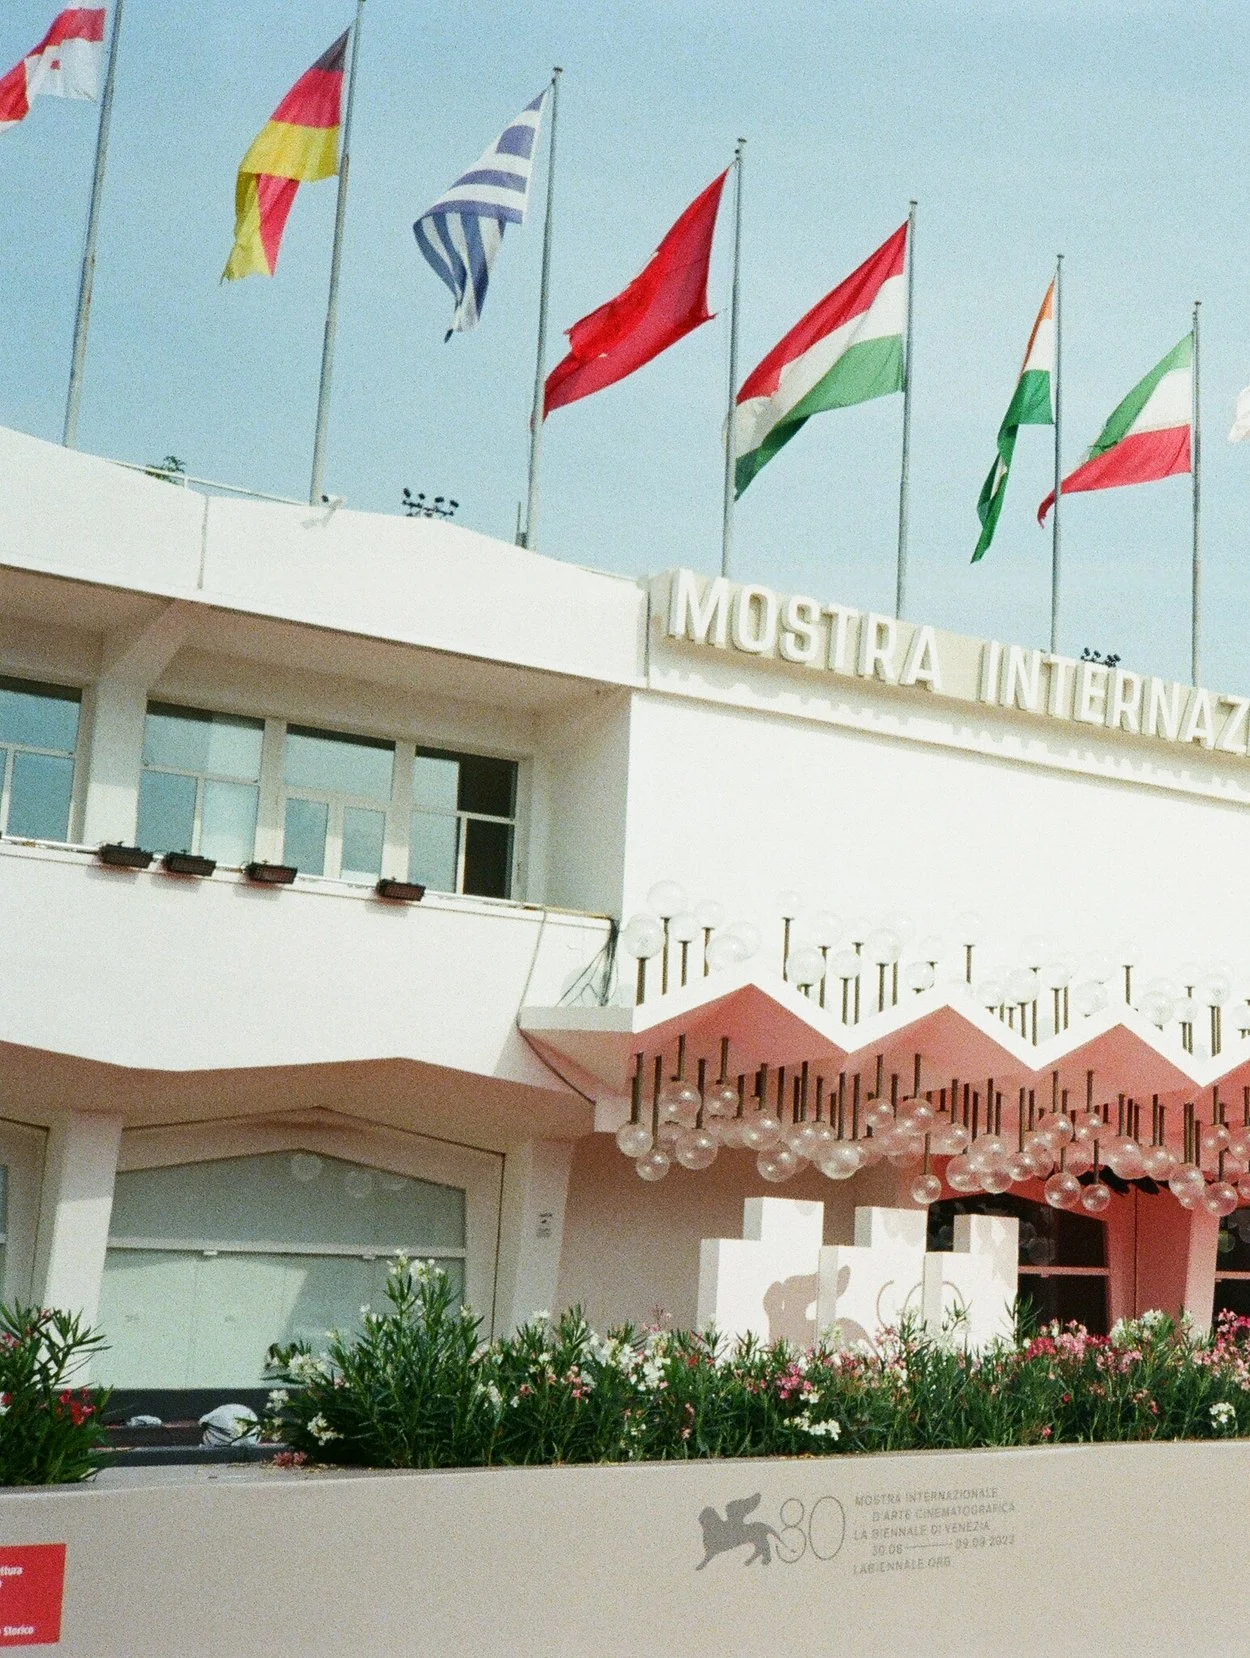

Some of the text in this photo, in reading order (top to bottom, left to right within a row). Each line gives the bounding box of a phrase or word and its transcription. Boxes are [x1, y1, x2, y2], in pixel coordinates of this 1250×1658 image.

[668, 568, 943, 693] MOSTRA
[855, 1487, 998, 1506] MOSTRA INTERNAZIONALE
[915, 1502, 1016, 1519] CINEMATOGRAFICA
[775, 1496, 846, 1564] 80
[853, 1521, 990, 1541] LA BIENNALE DI VENEZIA
